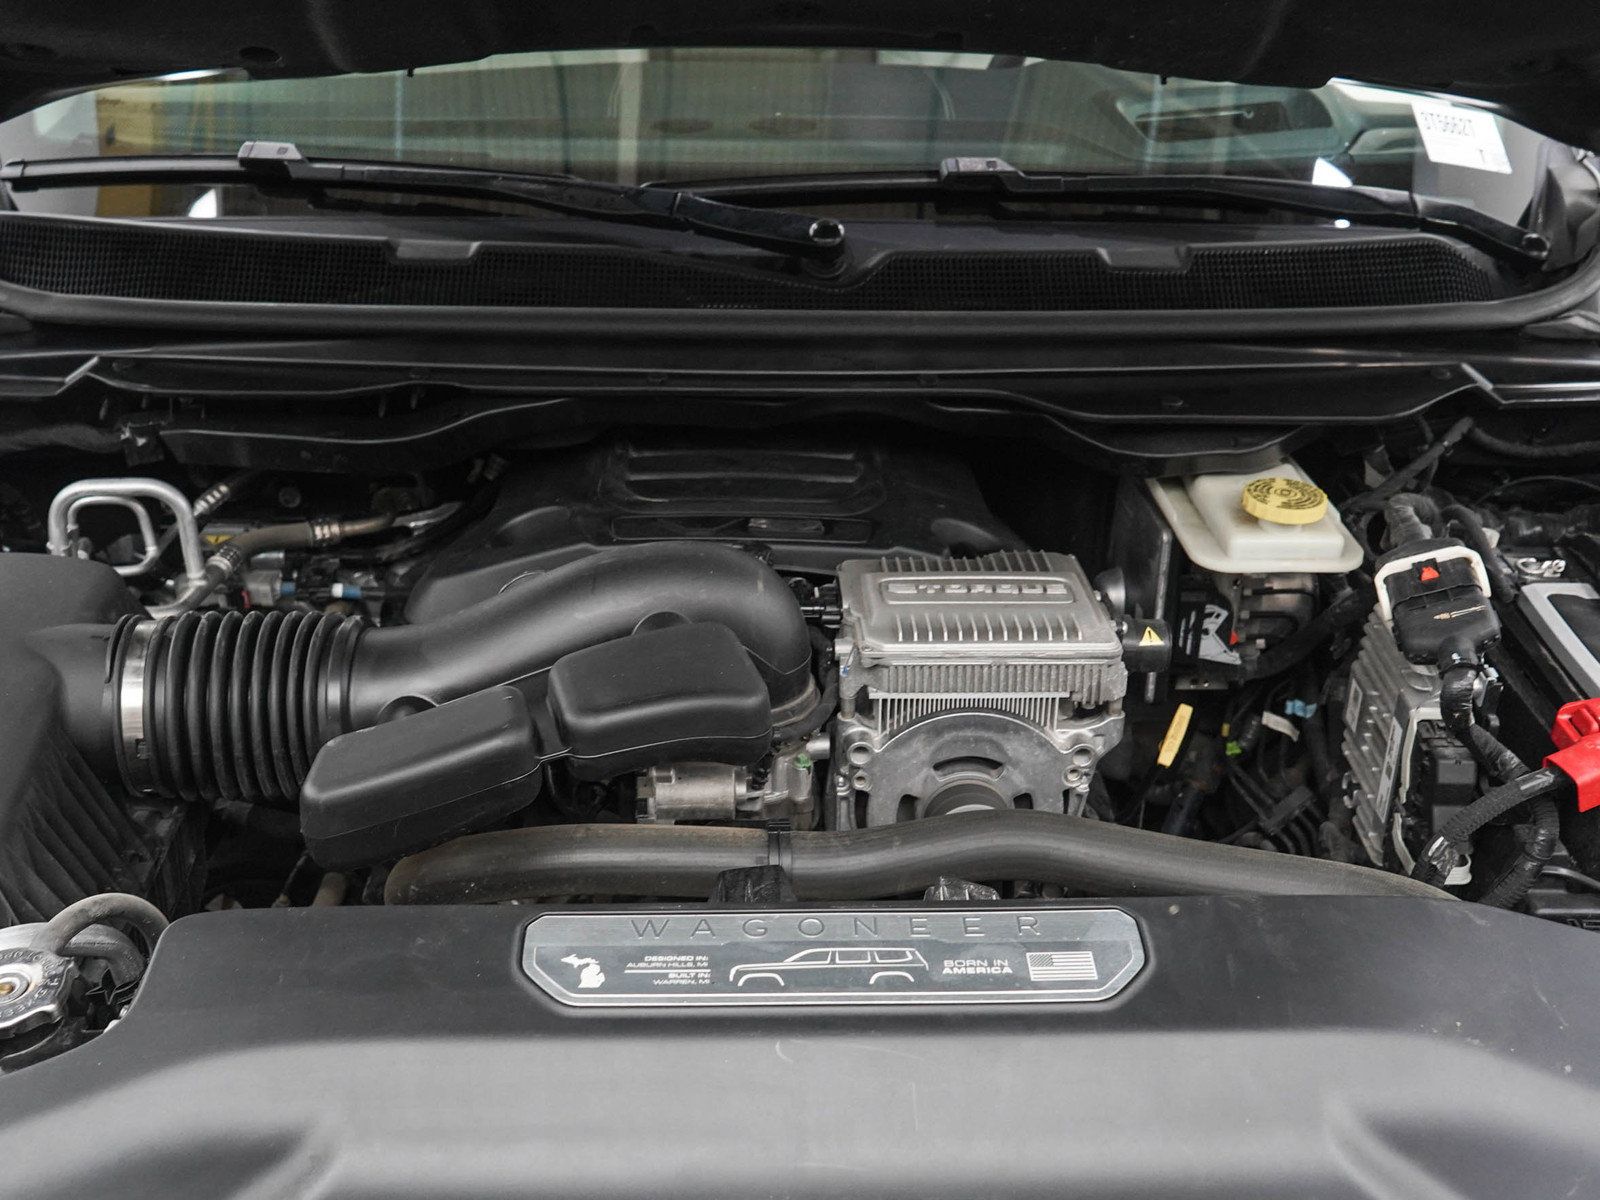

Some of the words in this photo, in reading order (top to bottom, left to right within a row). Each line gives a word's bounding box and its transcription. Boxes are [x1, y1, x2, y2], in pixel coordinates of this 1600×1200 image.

[631, 916, 1042, 939] WAGONEER
[943, 959, 988, 967] BORN
[993, 959, 1009, 967] IN
[942, 966, 1013, 975] AMERICA
